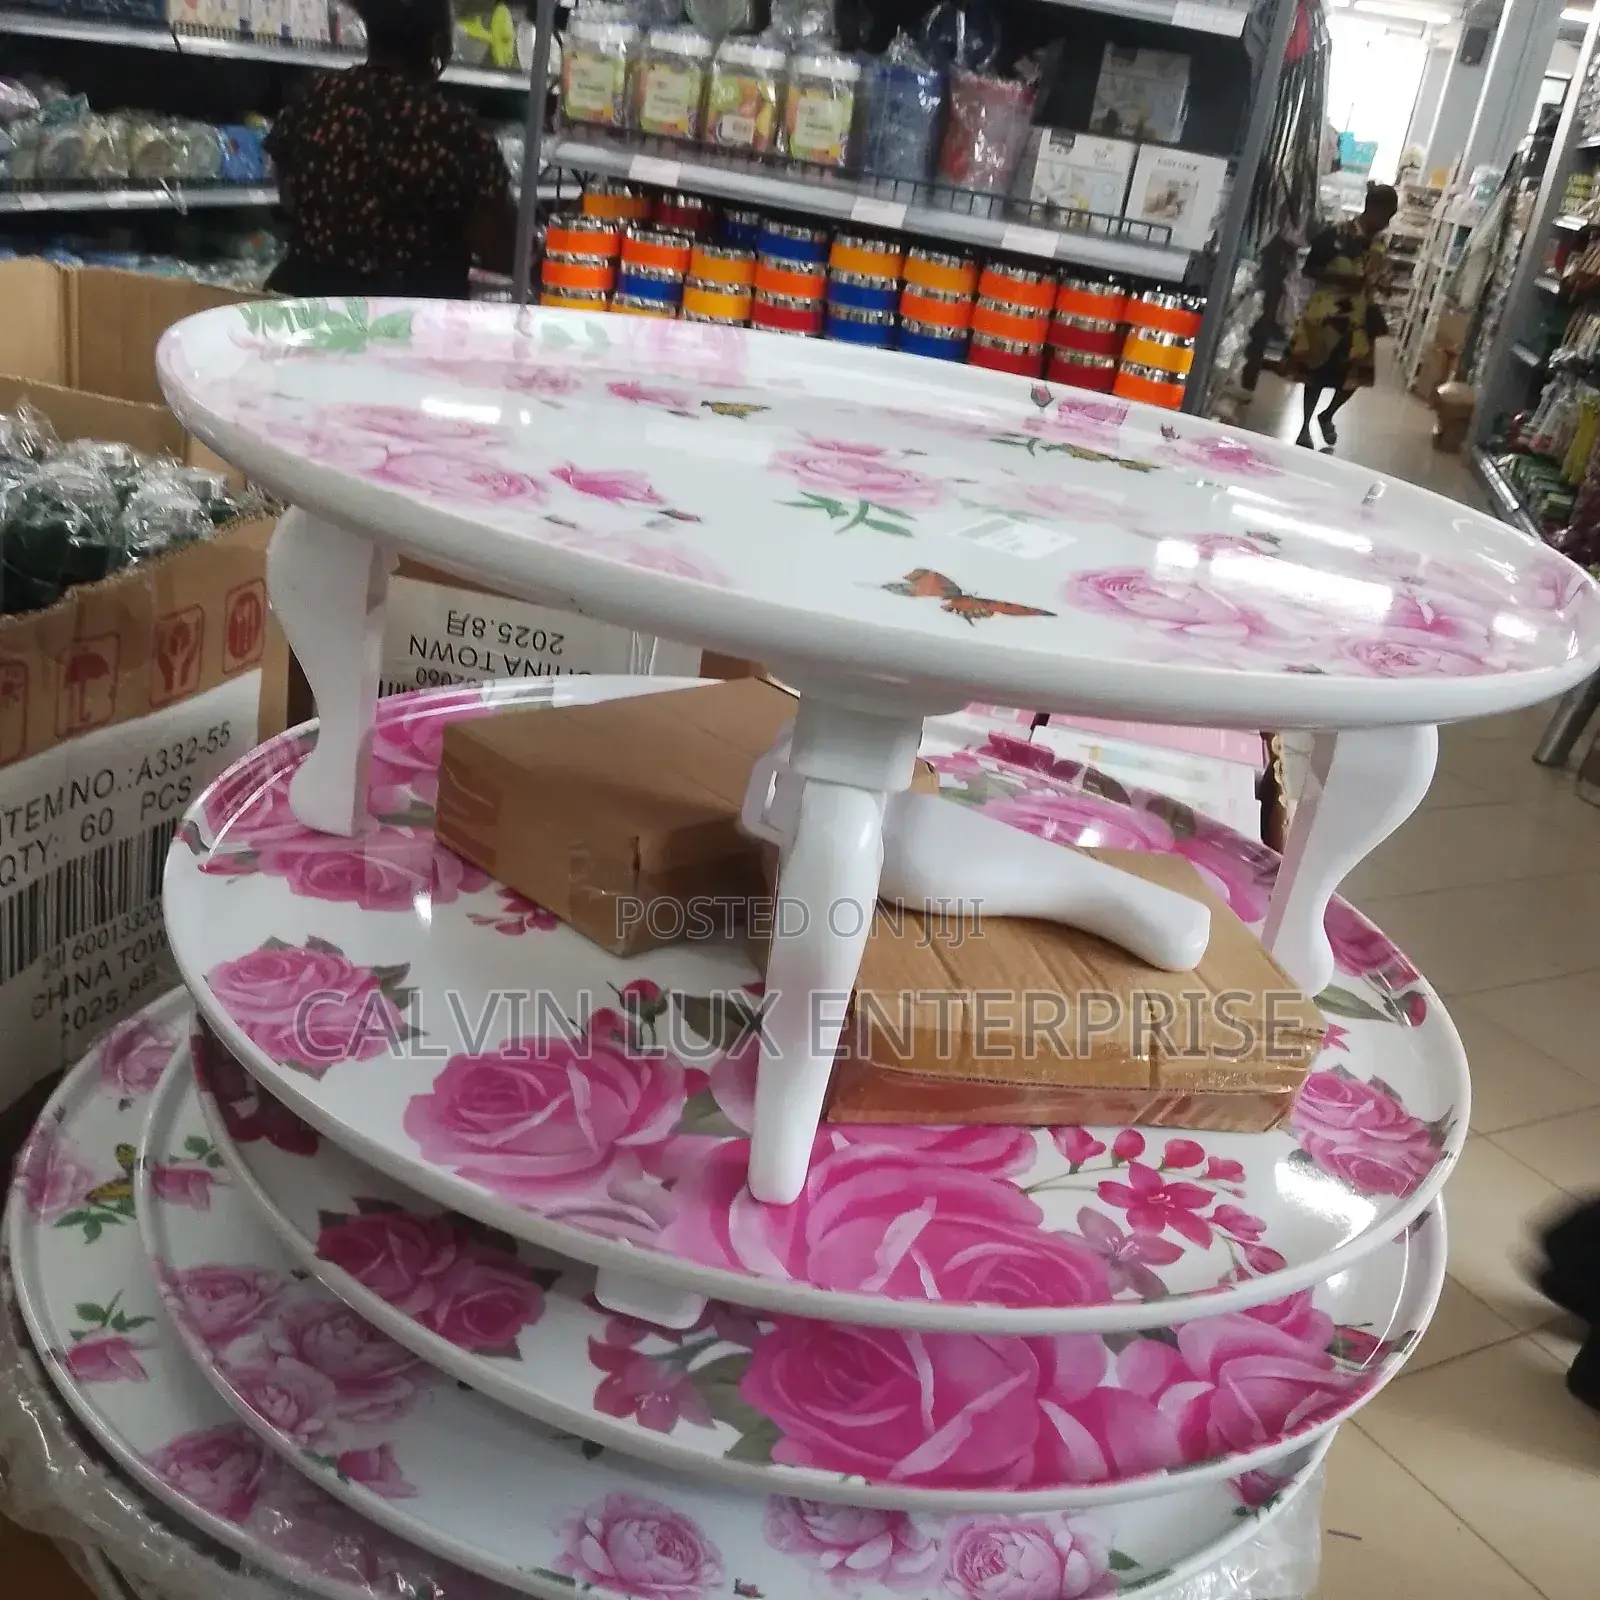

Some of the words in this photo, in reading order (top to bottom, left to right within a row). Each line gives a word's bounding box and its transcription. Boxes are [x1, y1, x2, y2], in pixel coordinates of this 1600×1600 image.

[408, 634, 496, 674] TOWN
[446, 609, 565, 656] 2025.8月
[0, 831, 60, 888] QTY:
[80, 807, 114, 843] 60
[140, 775, 193, 821] PCS
[30, 960, 112, 1020] CHINA
